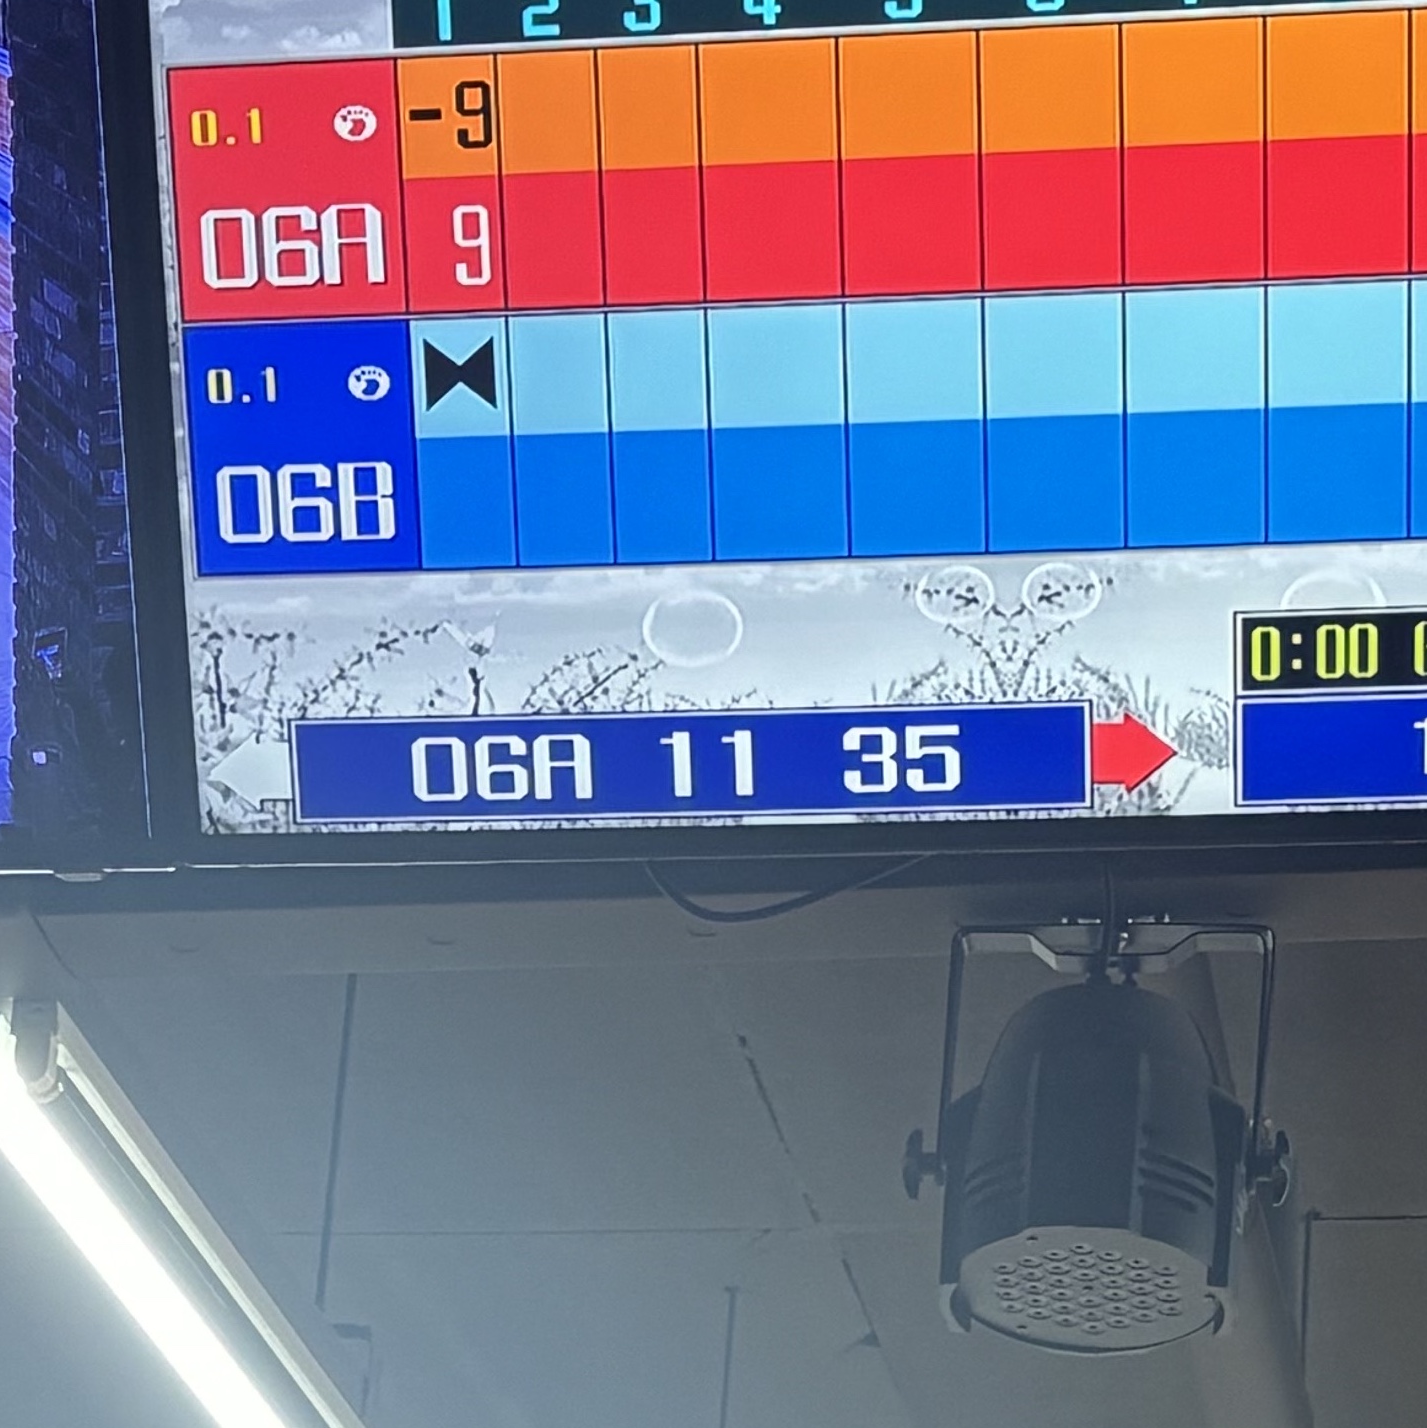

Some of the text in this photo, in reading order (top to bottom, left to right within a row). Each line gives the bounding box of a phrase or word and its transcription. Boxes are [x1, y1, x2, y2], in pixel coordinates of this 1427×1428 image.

[190, 108, 264, 147] 0.1
[199, 203, 492, 290] 06A 9
[206, 366, 277, 405] 0.1
[215, 461, 397, 545] 06B
[1250, 621, 1380, 682] 0:00
[410, 723, 964, 803] 06A 11 35
